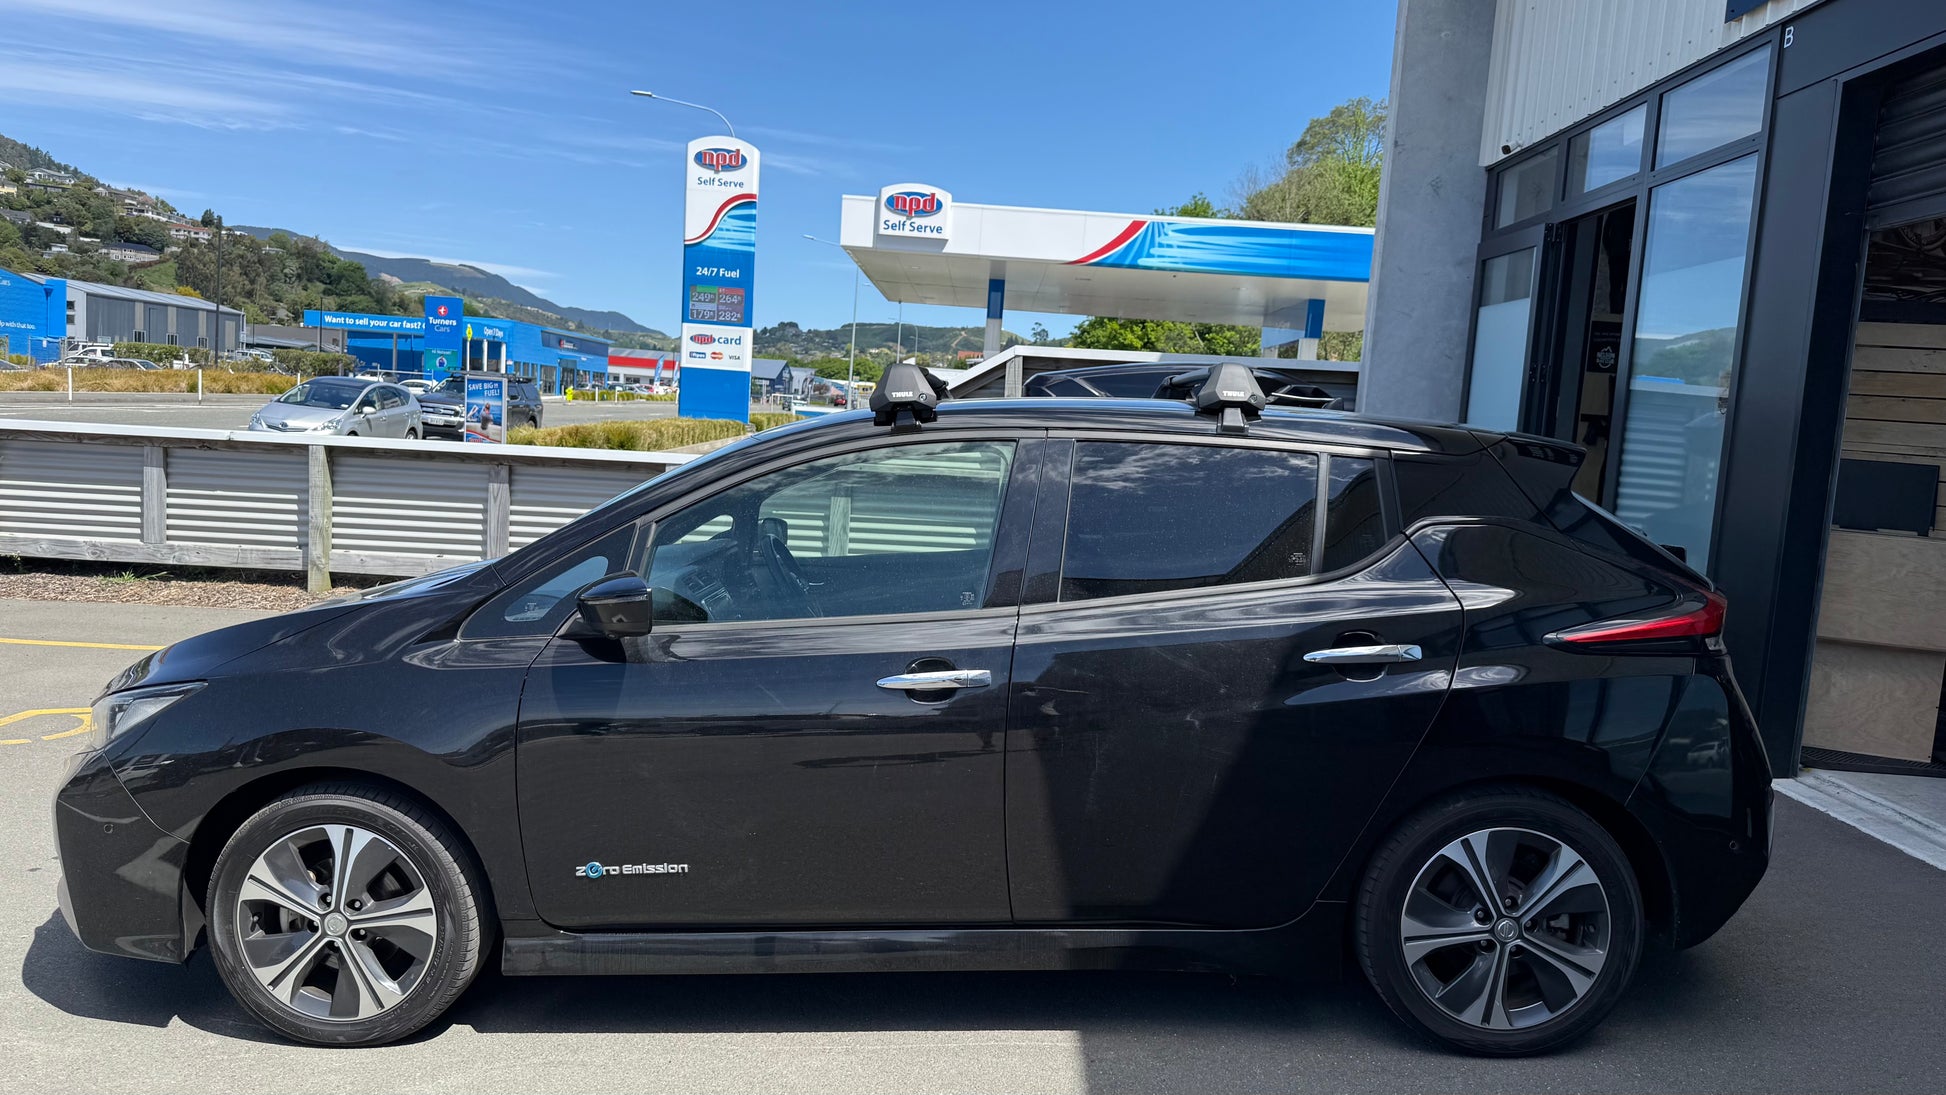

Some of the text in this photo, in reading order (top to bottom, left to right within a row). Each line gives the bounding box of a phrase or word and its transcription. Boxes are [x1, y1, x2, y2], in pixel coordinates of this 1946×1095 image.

[1784, 25, 1794, 48] B
[702, 149, 741, 171] npd
[697, 176, 744, 188] Self Serve
[894, 193, 936, 216] npd
[883, 220, 943, 233] Self Serve
[696, 266, 740, 278] 24/7 Fuel
[324, 315, 344, 323] Want
[355, 317, 369, 325] sell
[369, 319, 388, 328] your
[389, 320, 402, 328] car
[402, 321, 421, 329] fast?
[428, 317, 456, 326] Turners
[434, 325, 451, 333] Cars
[717, 335, 742, 346] card
[484, 388, 500, 397] FUEL!
[622, 862, 689, 875] Emission
